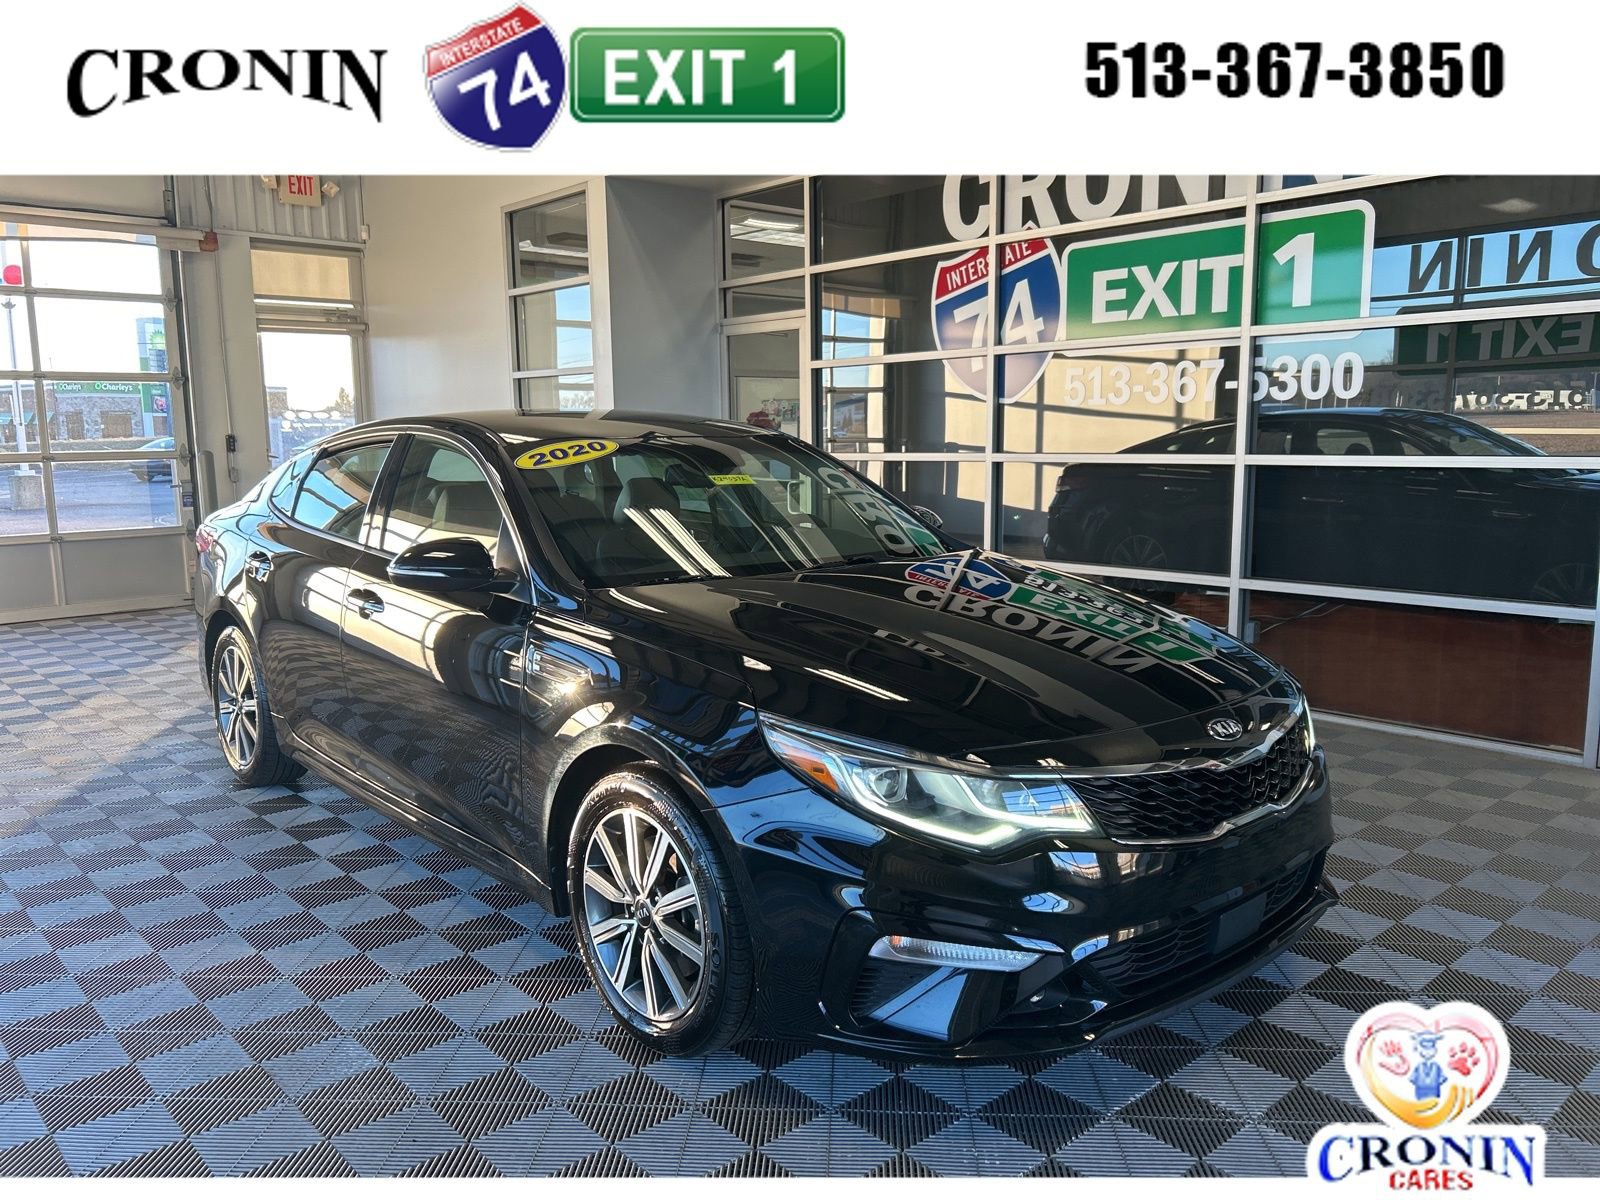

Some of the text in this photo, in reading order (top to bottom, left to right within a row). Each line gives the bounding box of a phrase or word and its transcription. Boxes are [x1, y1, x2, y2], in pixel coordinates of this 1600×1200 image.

[287, 174, 313, 196] EXIT
[1091, 233, 1315, 324] EXIT 1
[953, 278, 1045, 373] 74
[528, 441, 607, 467] 2020
[1212, 720, 1241, 737] KIA
